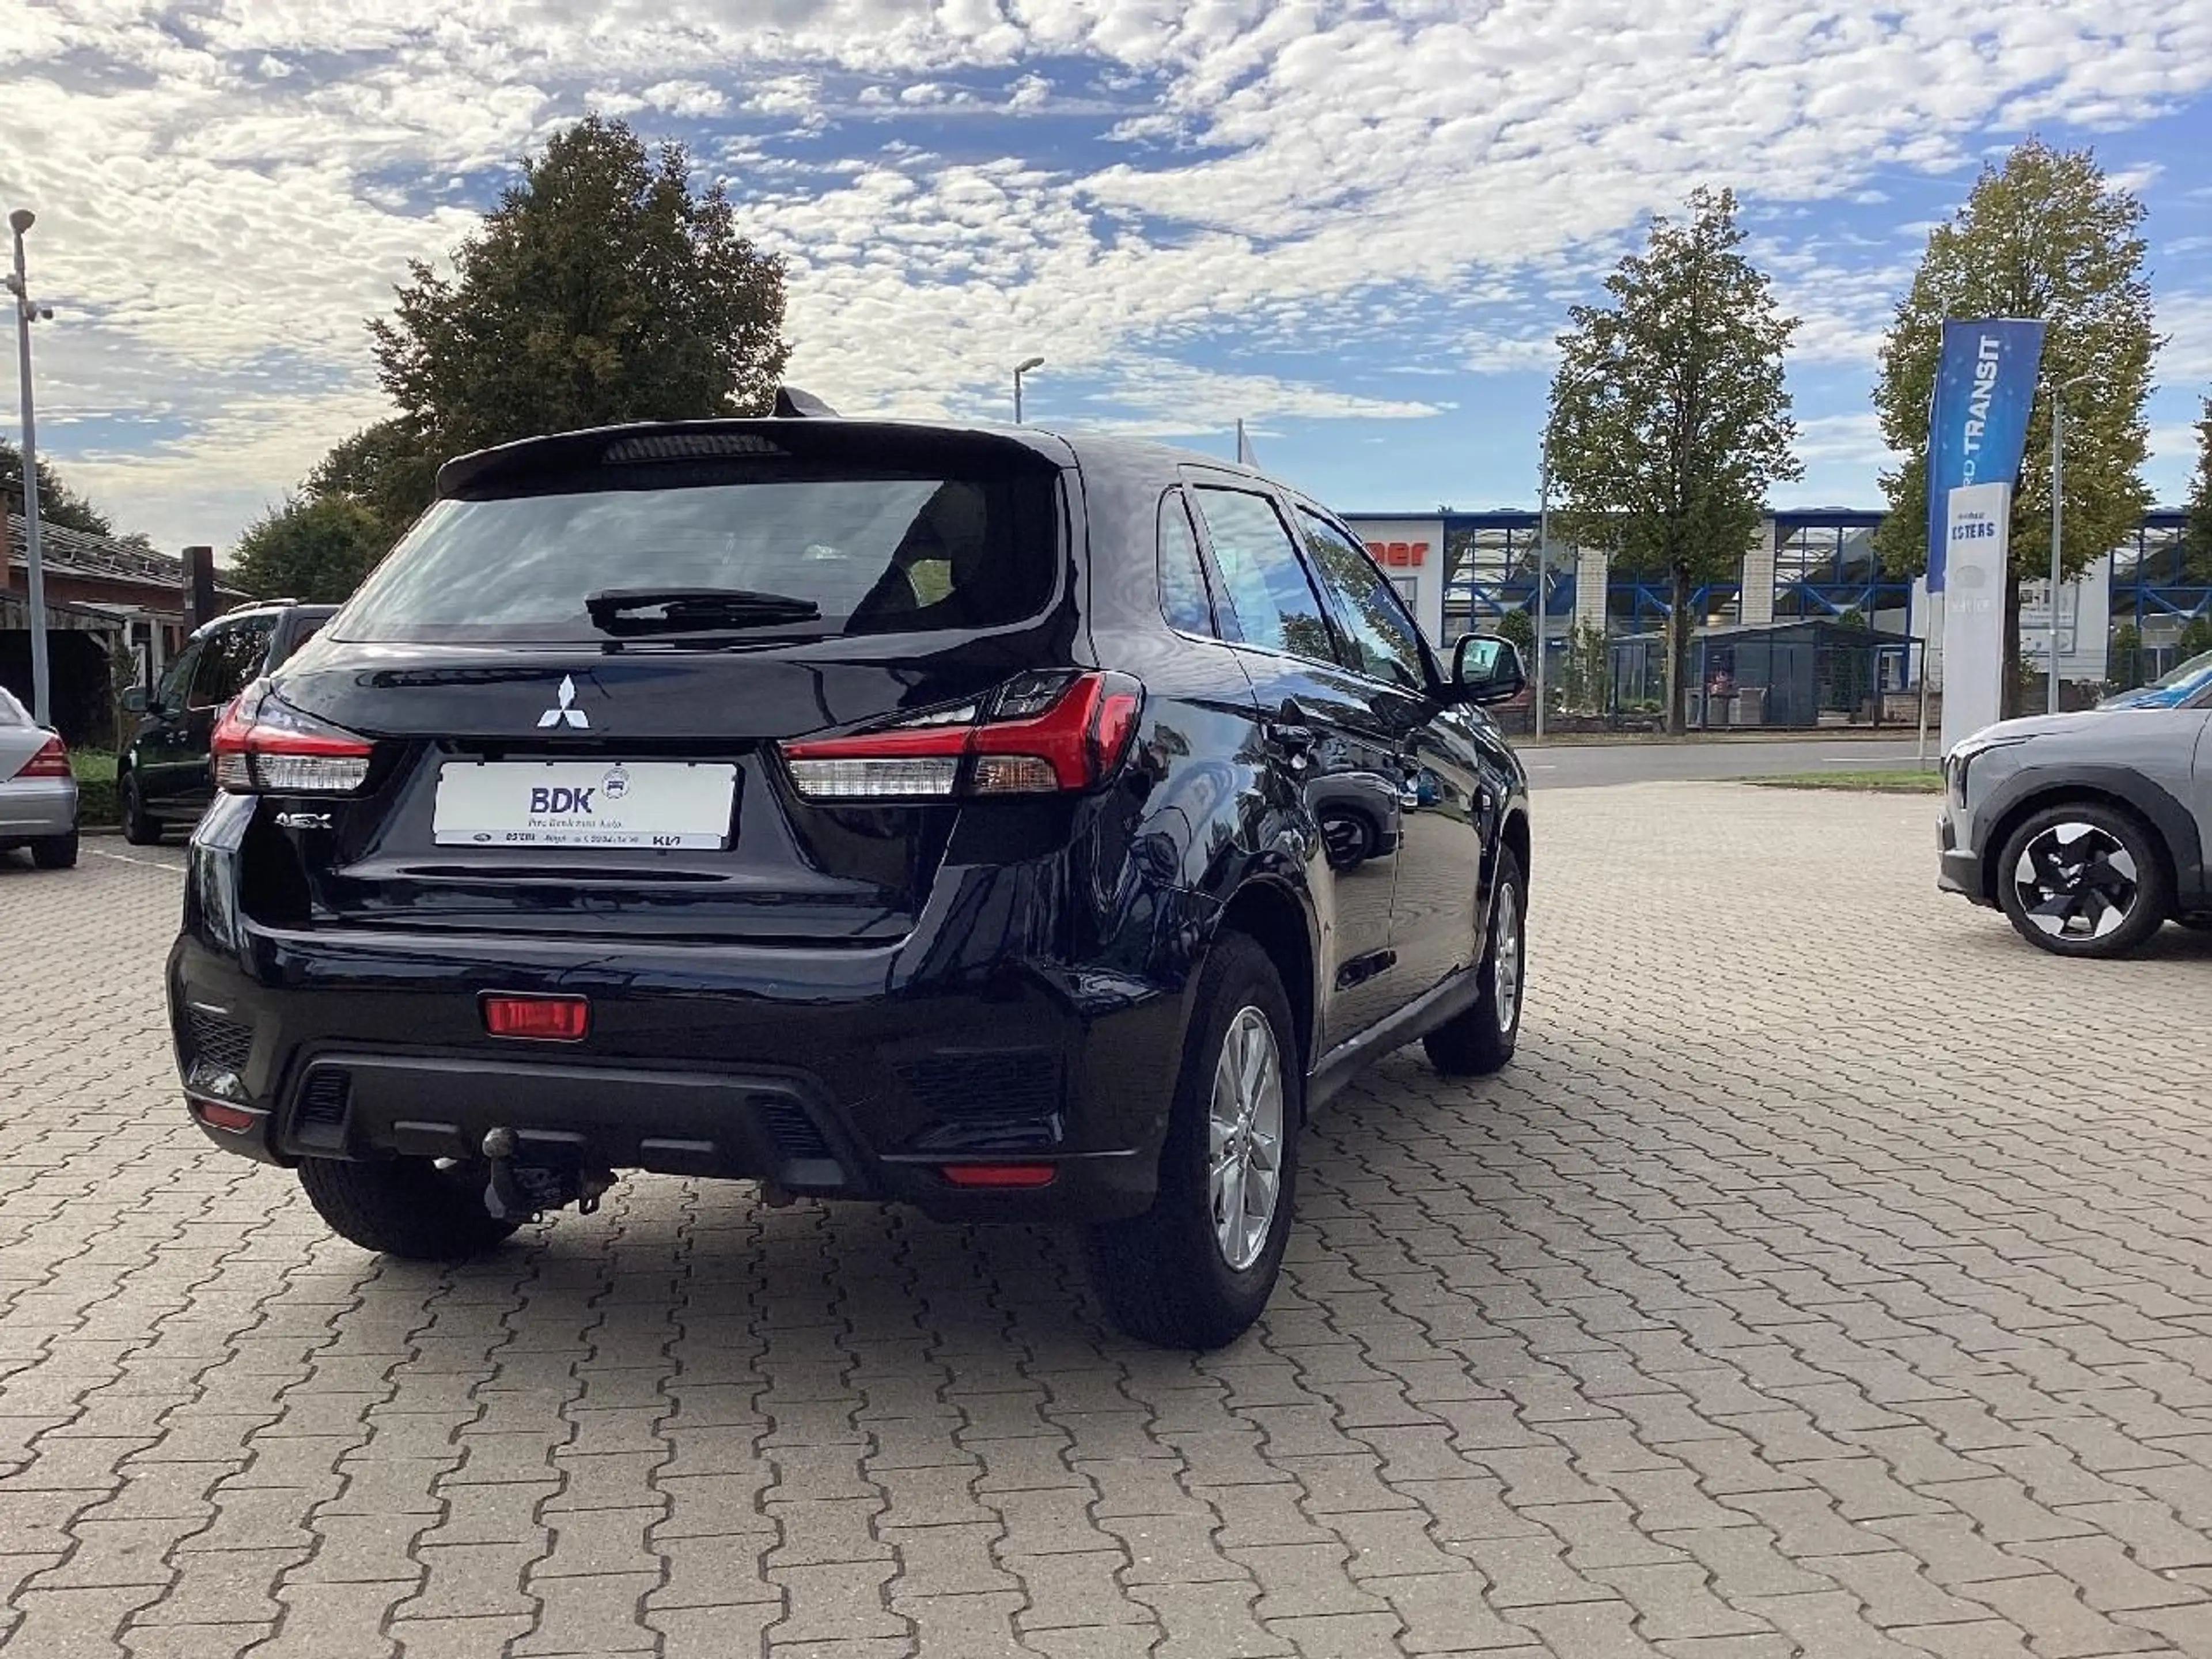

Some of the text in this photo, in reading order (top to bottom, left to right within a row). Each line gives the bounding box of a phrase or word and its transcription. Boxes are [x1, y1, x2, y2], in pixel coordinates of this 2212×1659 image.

[1963, 334, 2001, 455] TRANSIT
[531, 787, 596, 813] BDK
[653, 836, 681, 846] KIA
